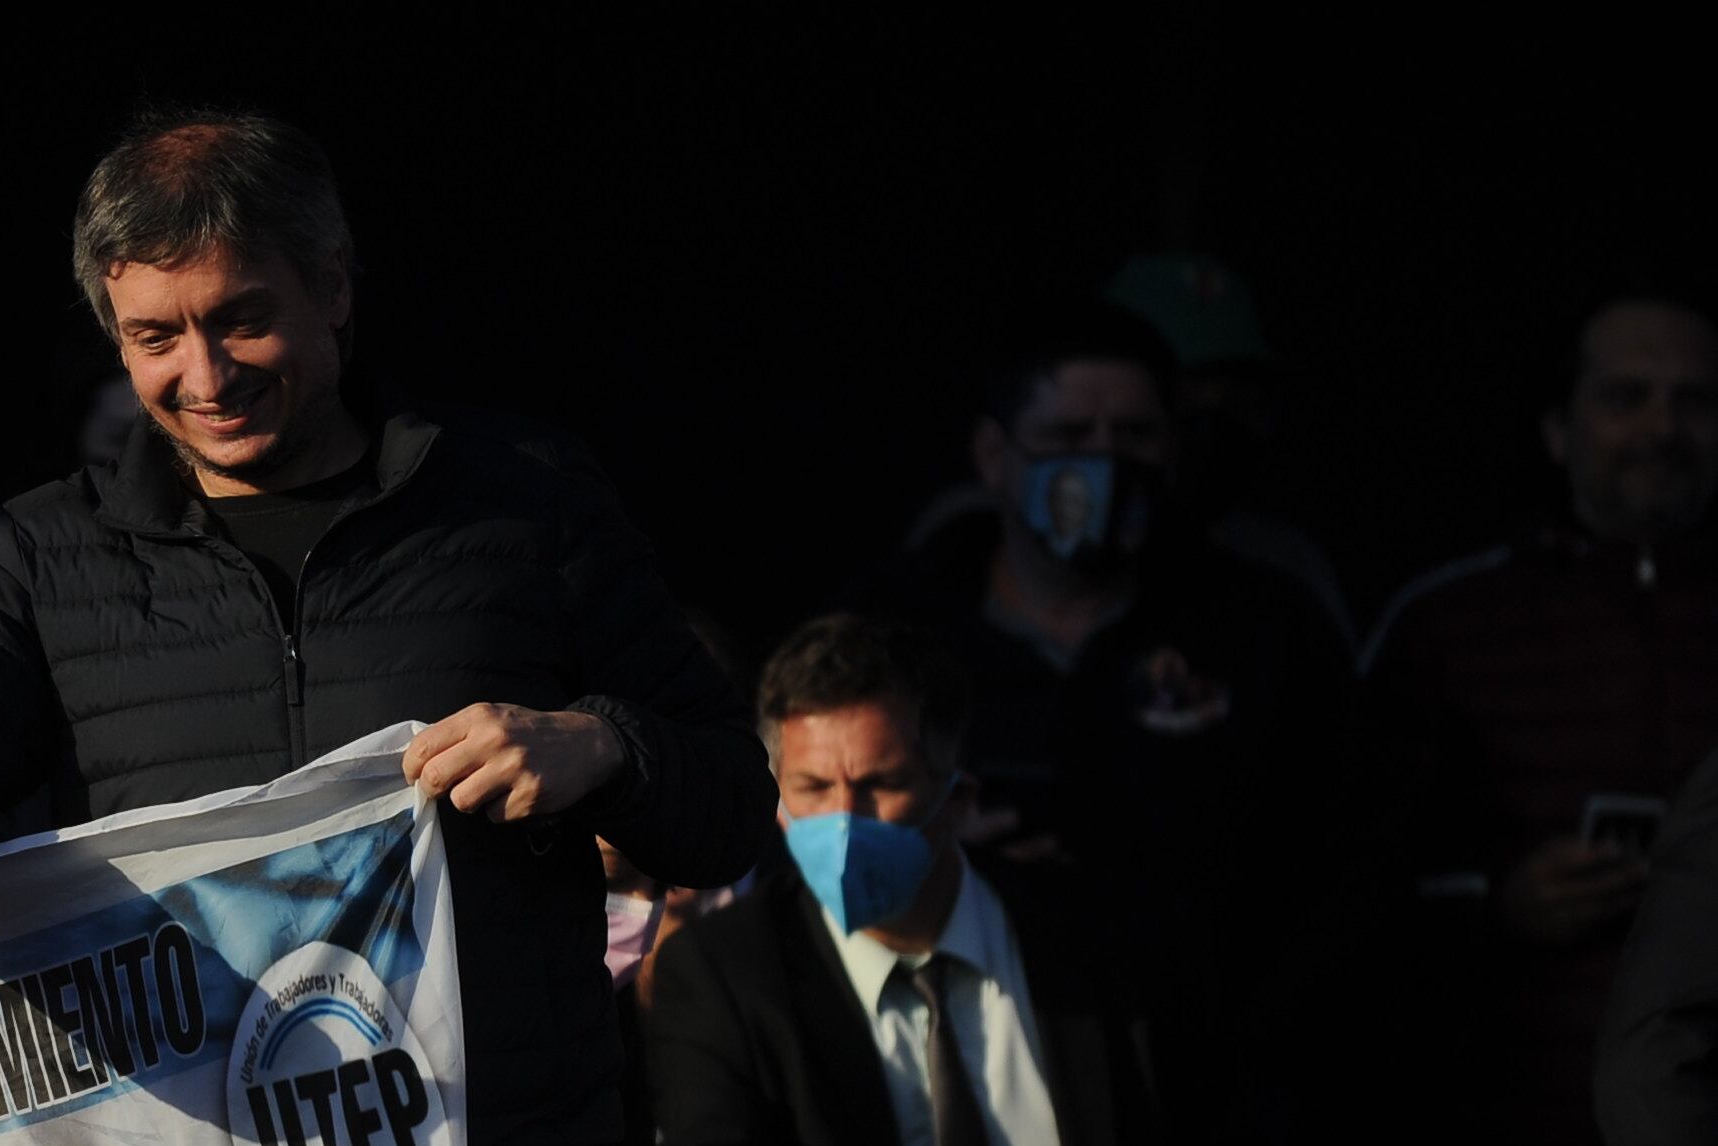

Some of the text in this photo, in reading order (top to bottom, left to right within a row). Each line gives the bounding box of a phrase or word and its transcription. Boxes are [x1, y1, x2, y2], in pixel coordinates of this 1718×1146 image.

[241, 972, 395, 1084] Unión de Trabajadores y Trabajadoras
